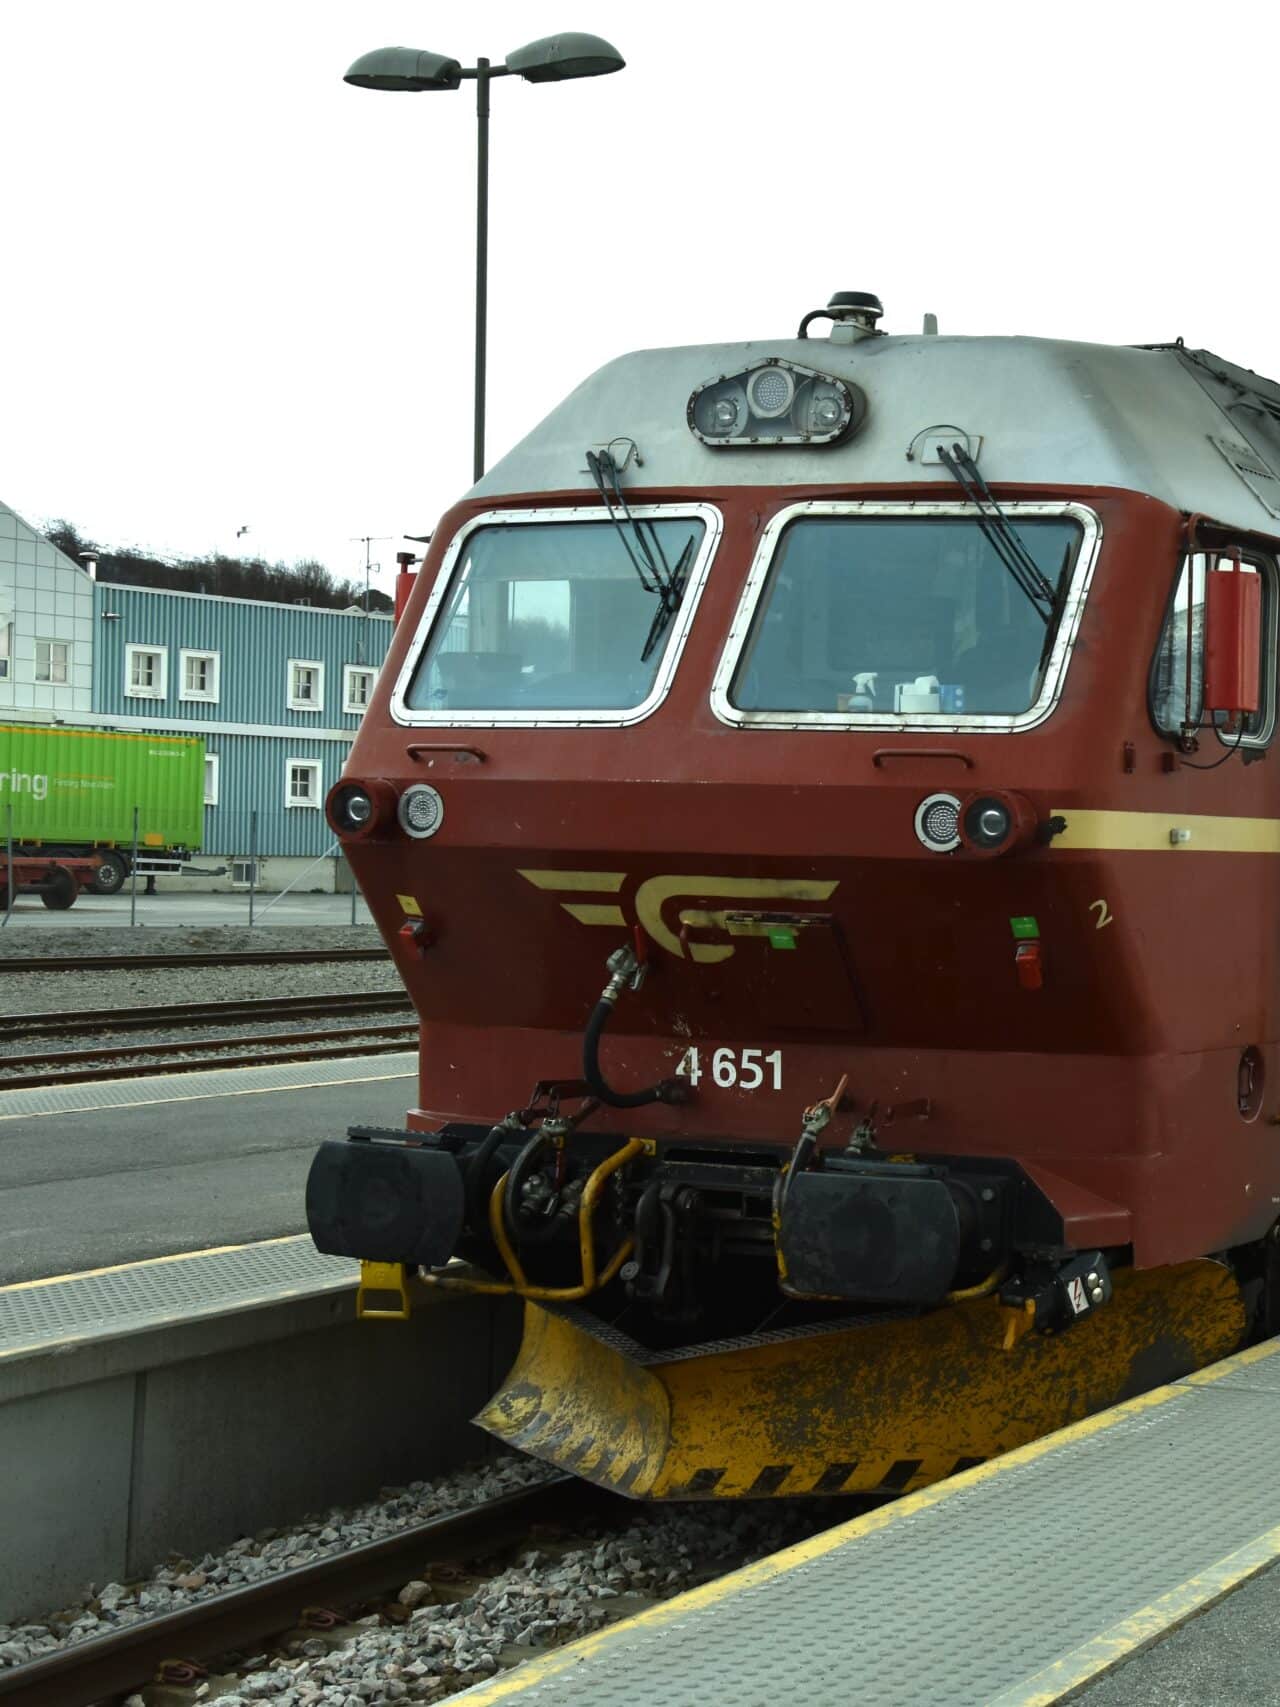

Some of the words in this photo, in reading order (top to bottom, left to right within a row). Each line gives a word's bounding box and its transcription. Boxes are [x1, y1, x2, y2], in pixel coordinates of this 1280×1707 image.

[1088, 899, 1113, 930] 2
[675, 1046, 703, 1086] 4
[712, 1047, 782, 1090] 651
